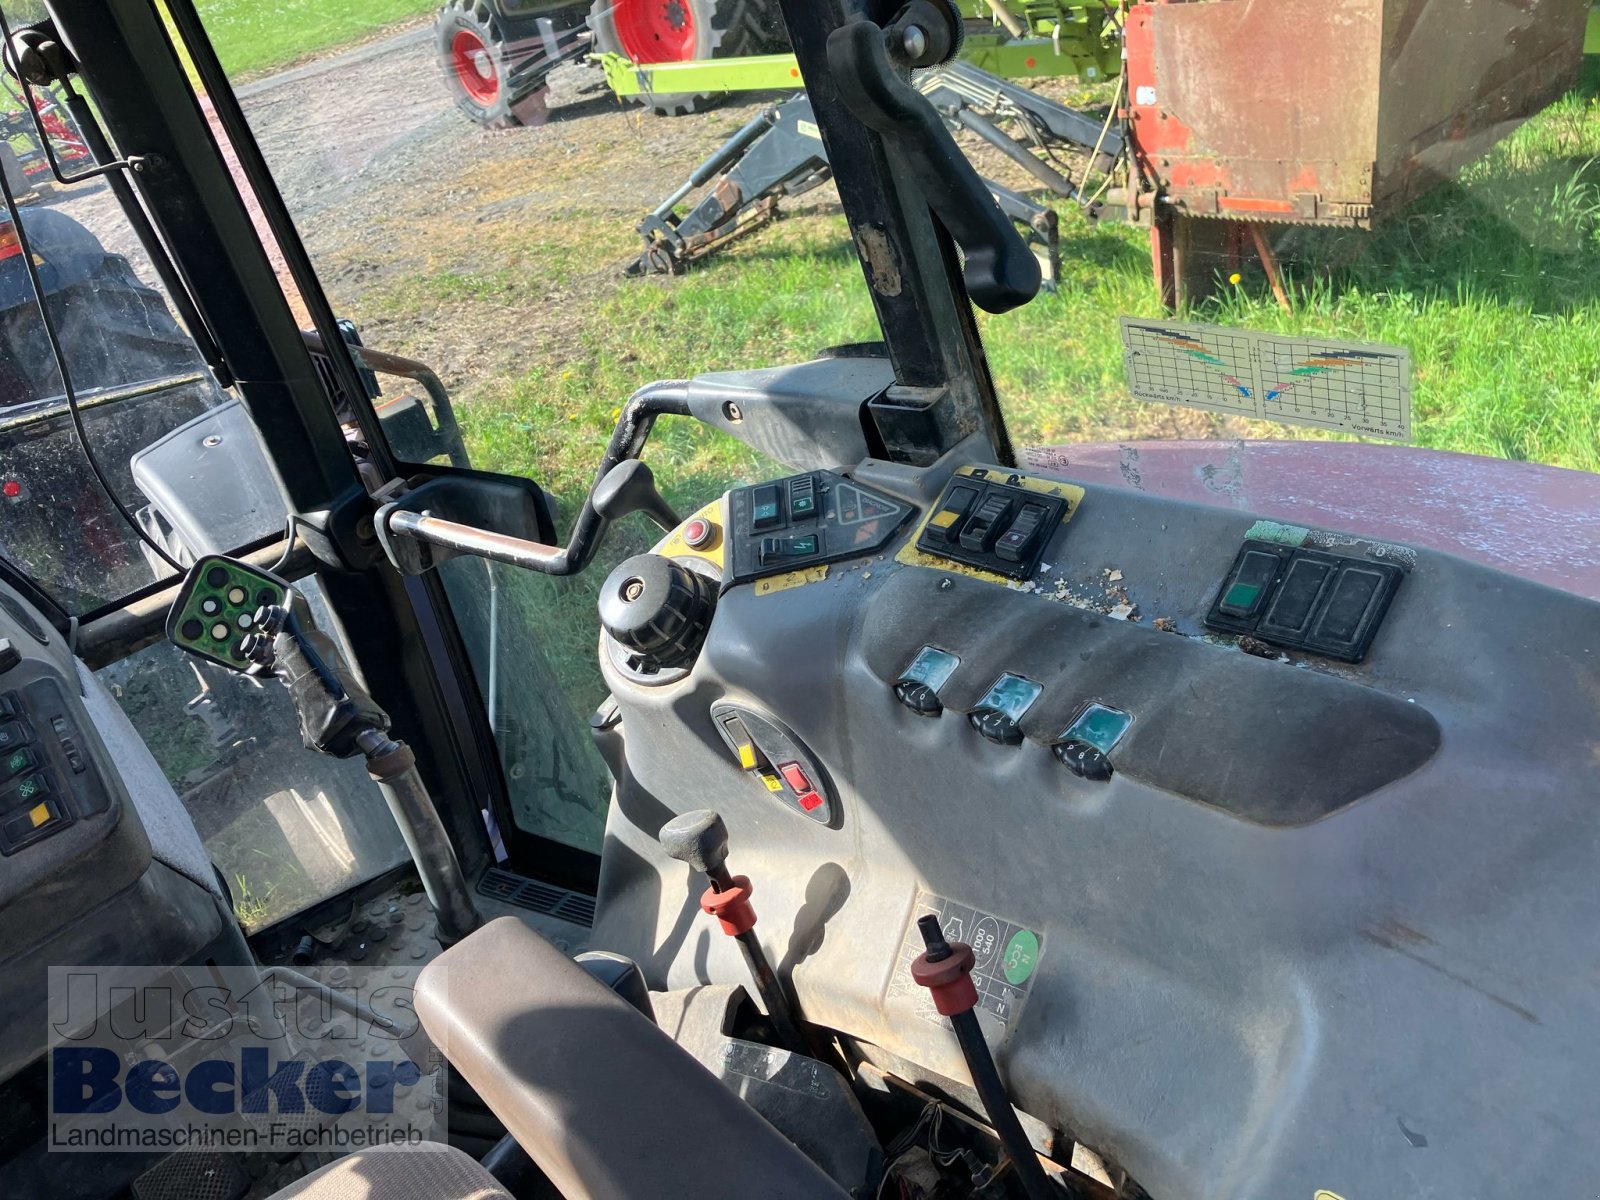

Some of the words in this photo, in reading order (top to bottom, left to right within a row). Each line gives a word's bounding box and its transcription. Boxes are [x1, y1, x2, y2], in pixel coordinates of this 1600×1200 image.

[1351, 423, 1384, 435] Vorwärts
[1386, 429, 1404, 438] km/h
[1078, 751, 1085, 760] 8
[1093, 753, 1101, 761] 7
[972, 928, 986, 953] 1000
[982, 934, 995, 955] 540
[996, 1003, 1005, 1014] N
